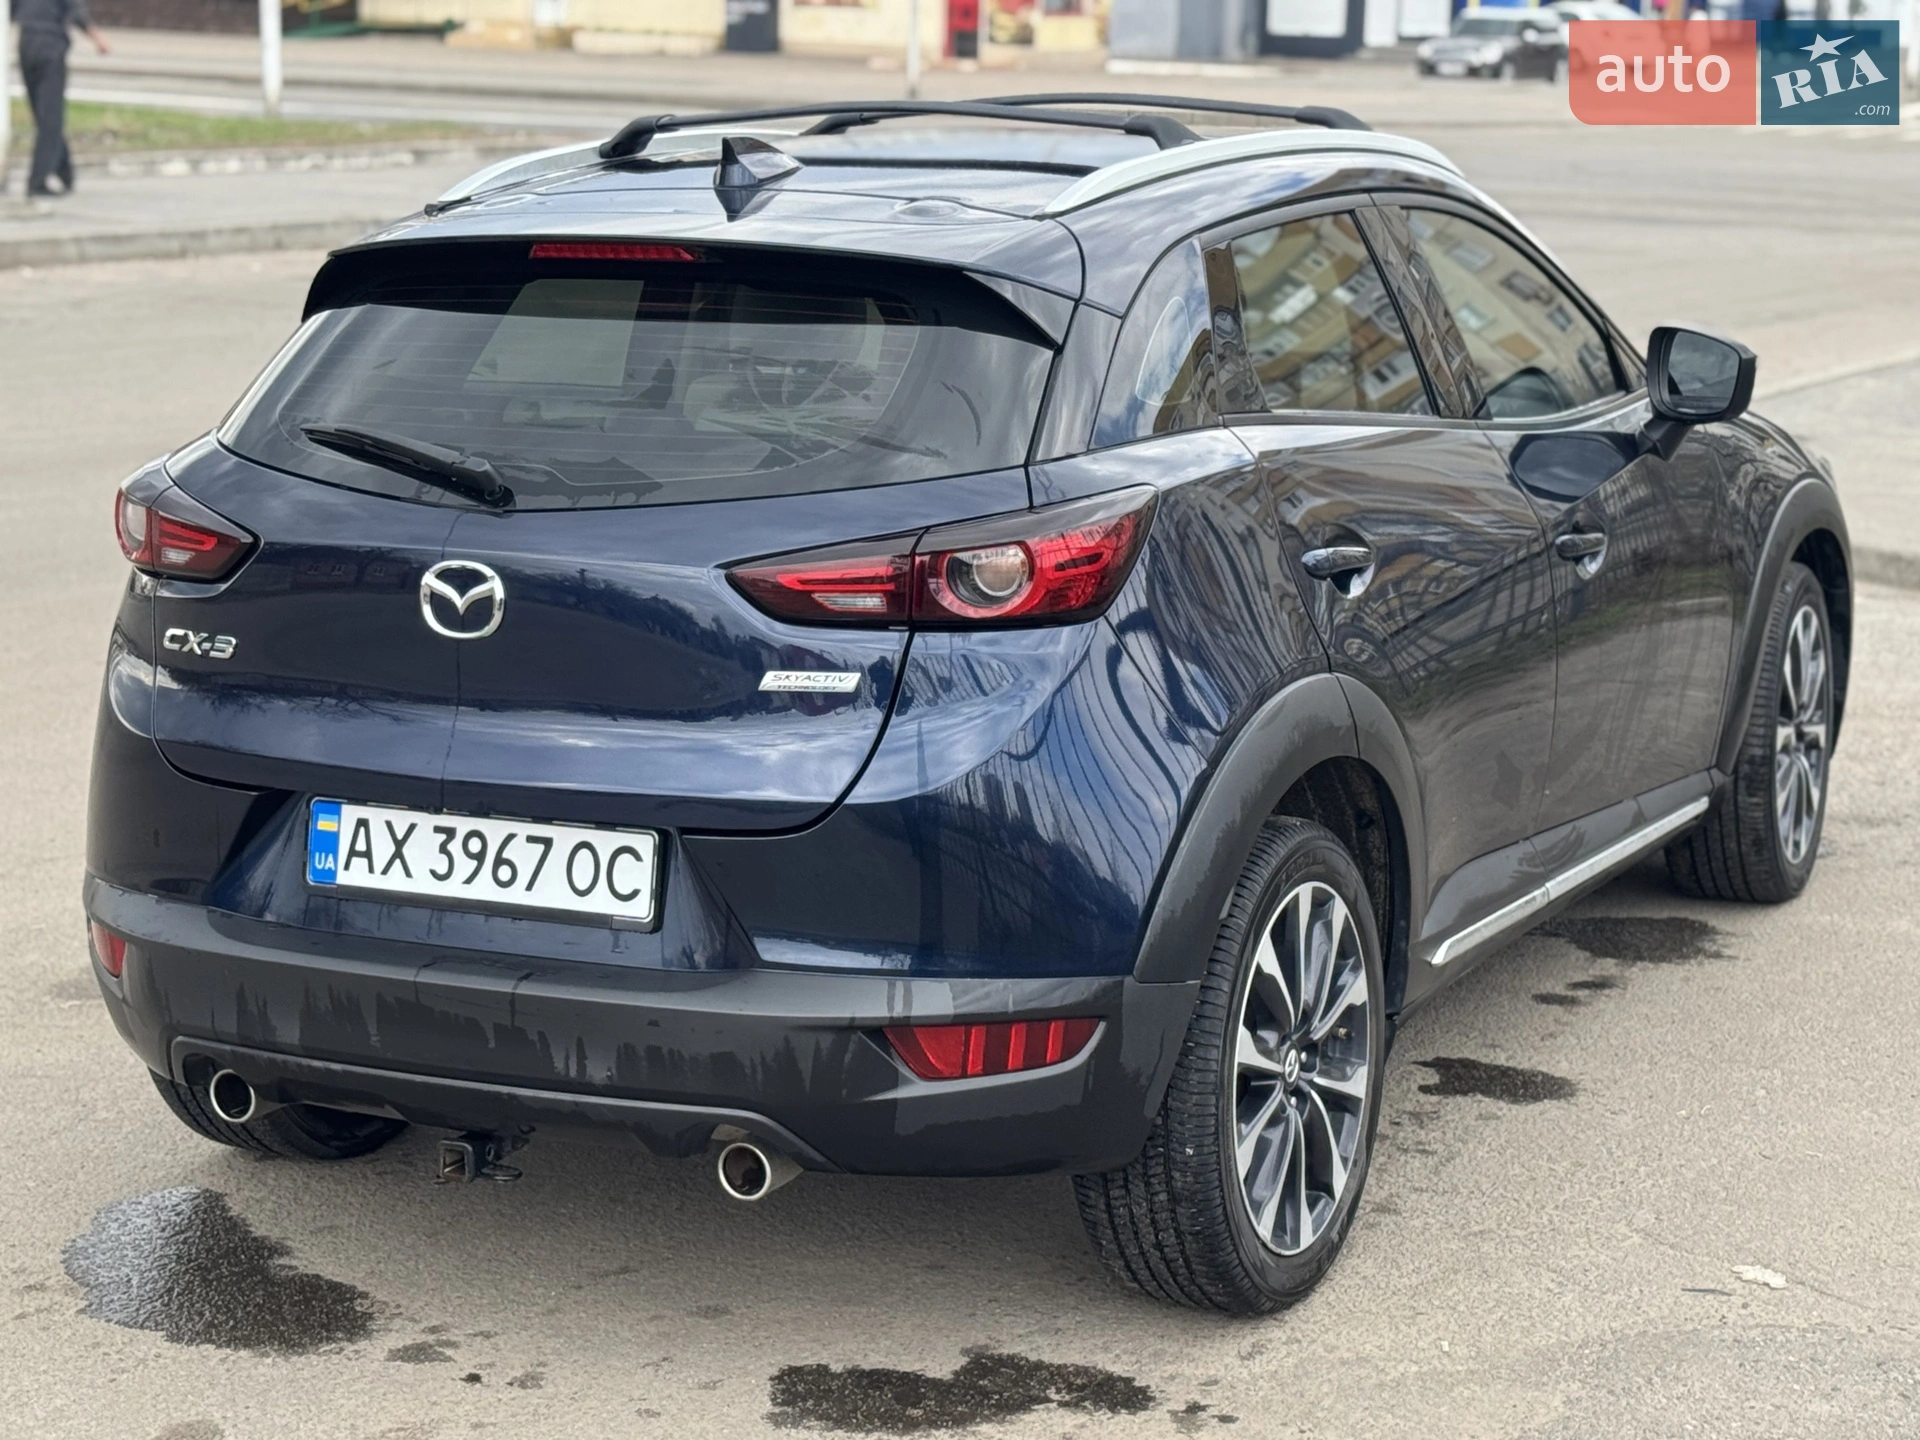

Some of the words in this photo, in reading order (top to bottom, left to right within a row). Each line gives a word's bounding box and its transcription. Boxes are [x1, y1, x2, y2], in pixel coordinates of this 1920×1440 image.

[163, 628, 237, 659] CX-3
[771, 674, 849, 683] SKYACTIV
[314, 852, 335, 871] UA
[343, 817, 418, 879] AX
[428, 825, 554, 892] 3967
[566, 840, 644, 902] OC
